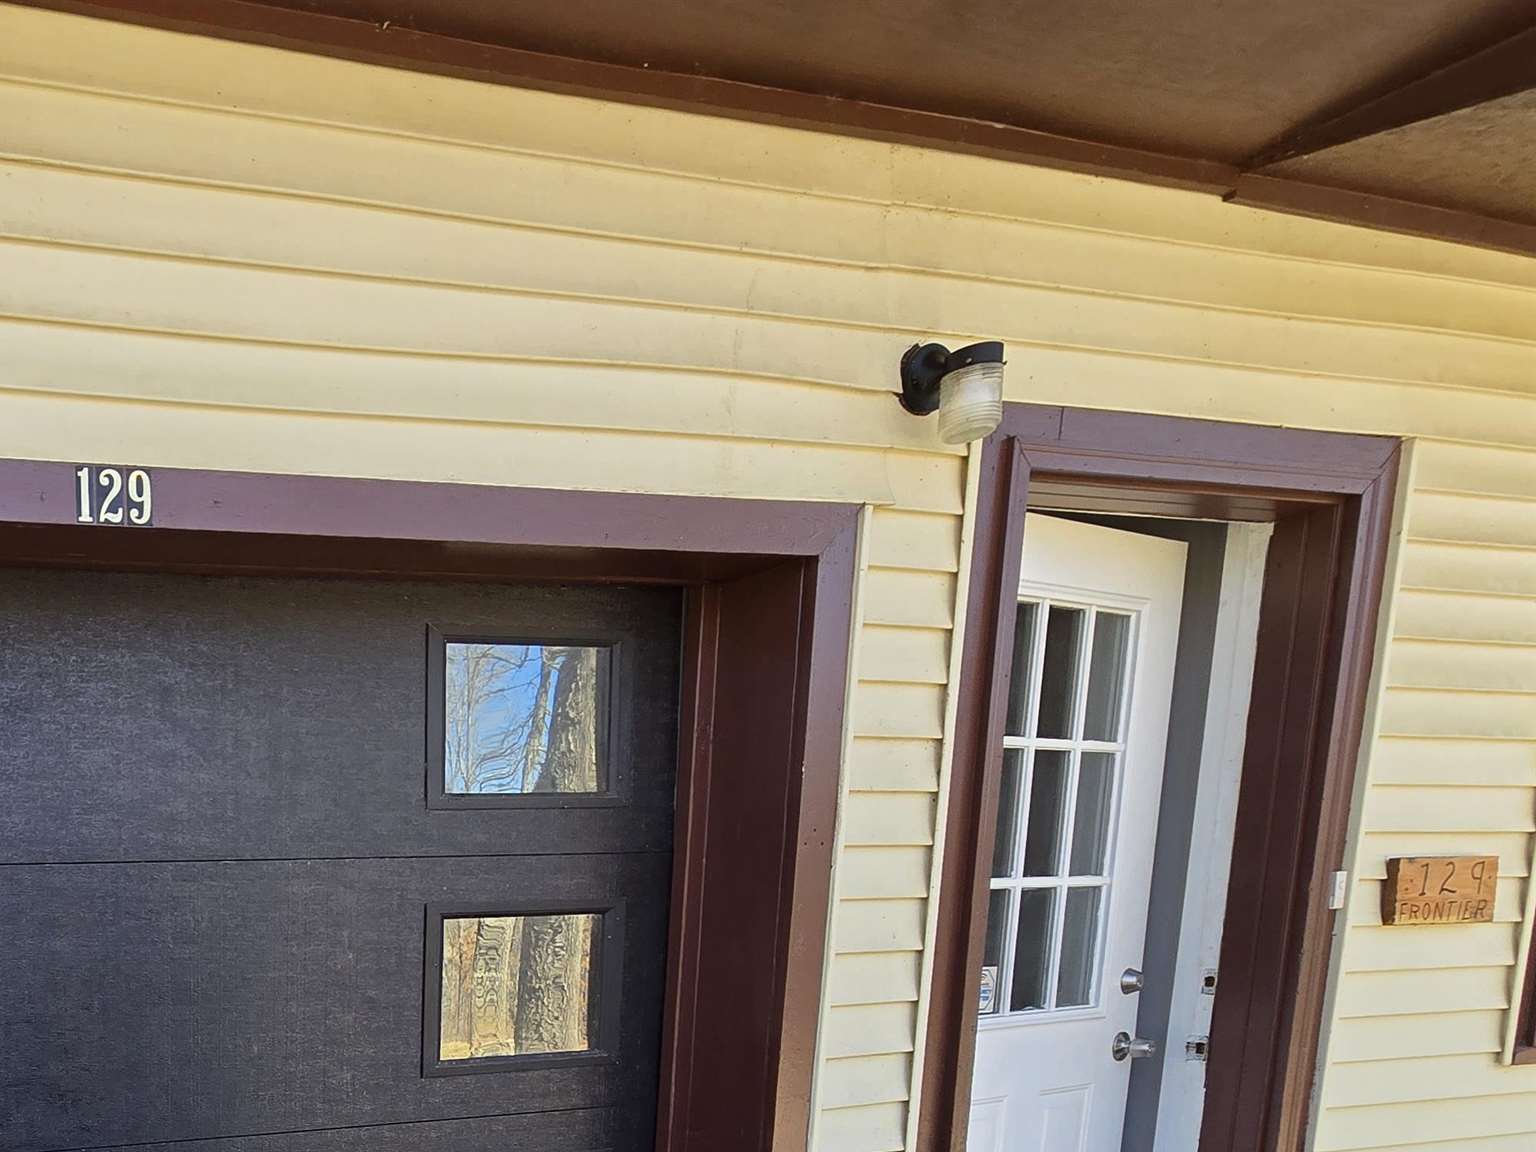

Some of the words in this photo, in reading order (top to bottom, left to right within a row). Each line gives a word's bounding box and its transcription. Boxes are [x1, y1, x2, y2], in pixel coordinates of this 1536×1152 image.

[76, 466, 152, 525] 129
[1418, 860, 1486, 897] 129
[1398, 899, 1488, 921] FRONTIER
